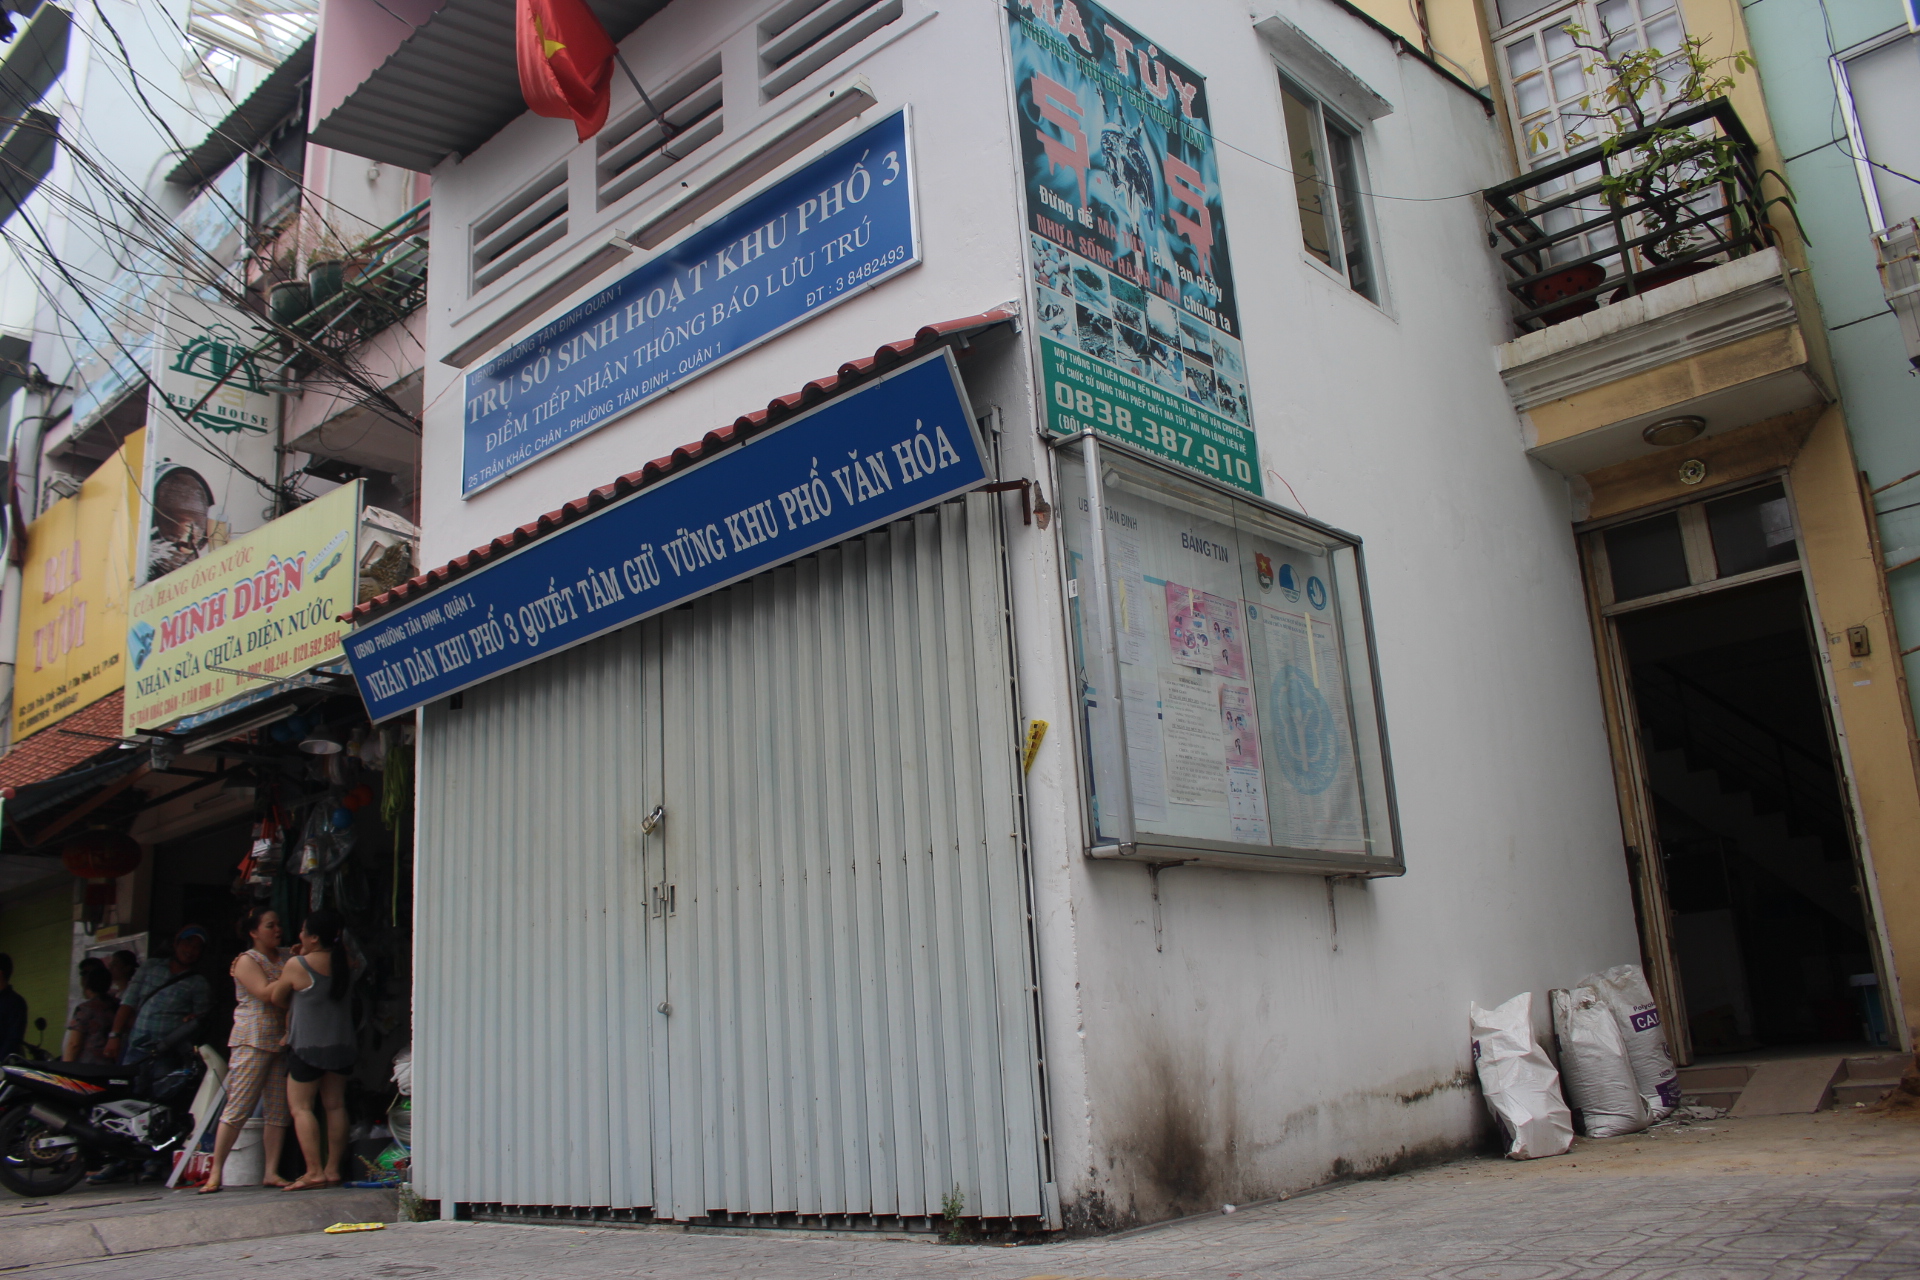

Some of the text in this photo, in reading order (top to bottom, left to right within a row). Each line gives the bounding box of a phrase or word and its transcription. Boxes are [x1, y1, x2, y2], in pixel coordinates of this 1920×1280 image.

[1020, 15, 1206, 153] KHÔNG THỬ DÙ CHỈ MỘT LẦN
[1103, 23, 1197, 119] TÚY
[467, 148, 900, 424] TRỤ SỞ SINH HOẠT KHU PHỐ 3
[836, 277, 844, 291] 3
[847, 245, 905, 285] 8482493
[1036, 213, 1232, 333] NHỰA SỐNG HÀNH TINH chúng ta
[1039, 184, 1074, 222] Đừng
[1077, 206, 1094, 230] để
[1097, 216, 1119, 243] MA
[1121, 230, 1145, 258] TÚY
[1175, 260, 1194, 285] tan
[1196, 275, 1223, 303] chảy
[471, 285, 622, 386] UBND PHƯỜNG TÂN ĐỊNH QUẬN 1
[485, 214, 872, 453] ĐIỂM TIẾP NHẬN THÔNG BÁO LƯU TRÚ
[167, 392, 269, 427] BEER HOUSE
[467, 475, 478, 488] 25
[480, 457, 504, 480] TRẦN
[506, 441, 532, 468] KHẮC
[534, 426, 562, 451] CHÂN
[569, 400, 614, 433] PHƯỜNG
[617, 382, 639, 408] TÂN
[641, 369, 669, 394] ĐỊNH
[678, 345, 712, 374] QUẬN
[716, 341, 721, 354] 1
[1053, 346, 1068, 362] MỌI
[1069, 352, 1091, 371] THÔNG
[1091, 362, 1103, 376] TIN
[1103, 367, 1119, 383] LIÊN
[1119, 375, 1137, 391] QUAN
[1137, 383, 1151, 398] ĐẾN
[1151, 389, 1166, 404] MUA
[1209, 416, 1222, 430] VẬN
[1054, 380, 1253, 485] 0838.387.910
[1055, 360, 1065, 375] TỔ
[1066, 367, 1085, 383] CHỨC
[1085, 374, 1095, 392] SỬ
[1096, 379, 1114, 400] DỤNG
[1114, 387, 1130, 403] TRÁI
[1130, 393, 1147, 410] PHÉP
[1147, 402, 1163, 418] CHẤT
[1164, 409, 1175, 422] MA
[1189, 421, 1200, 434] XIN
[1226, 437, 1239, 452] LIÊN
[366, 418, 961, 702] NHÂN DÂN KHU PHỐ 3 QUYẾT TÂM GIỮ VỮNG KHU PHỐ VĂN HÓA
[1104, 506, 1120, 525] TÂN
[1120, 513, 1138, 532] ĐỊNH
[1181, 528, 1229, 563] BẢNG TIN
[42, 540, 82, 604] BIA
[133, 546, 254, 618] CỬA HÀNG ỐNG NƯỚC
[158, 551, 307, 654] MINH DIỆN
[136, 666, 173, 699] NHẬN
[175, 651, 200, 684] SỬA
[204, 635, 243, 669] CHỮA
[246, 618, 285, 653] ĐIỆN
[288, 597, 333, 636] NƯỚC
[354, 593, 476, 660] UBND PHƯỜNG TÂN ĐỊNH, QUẬN 1
